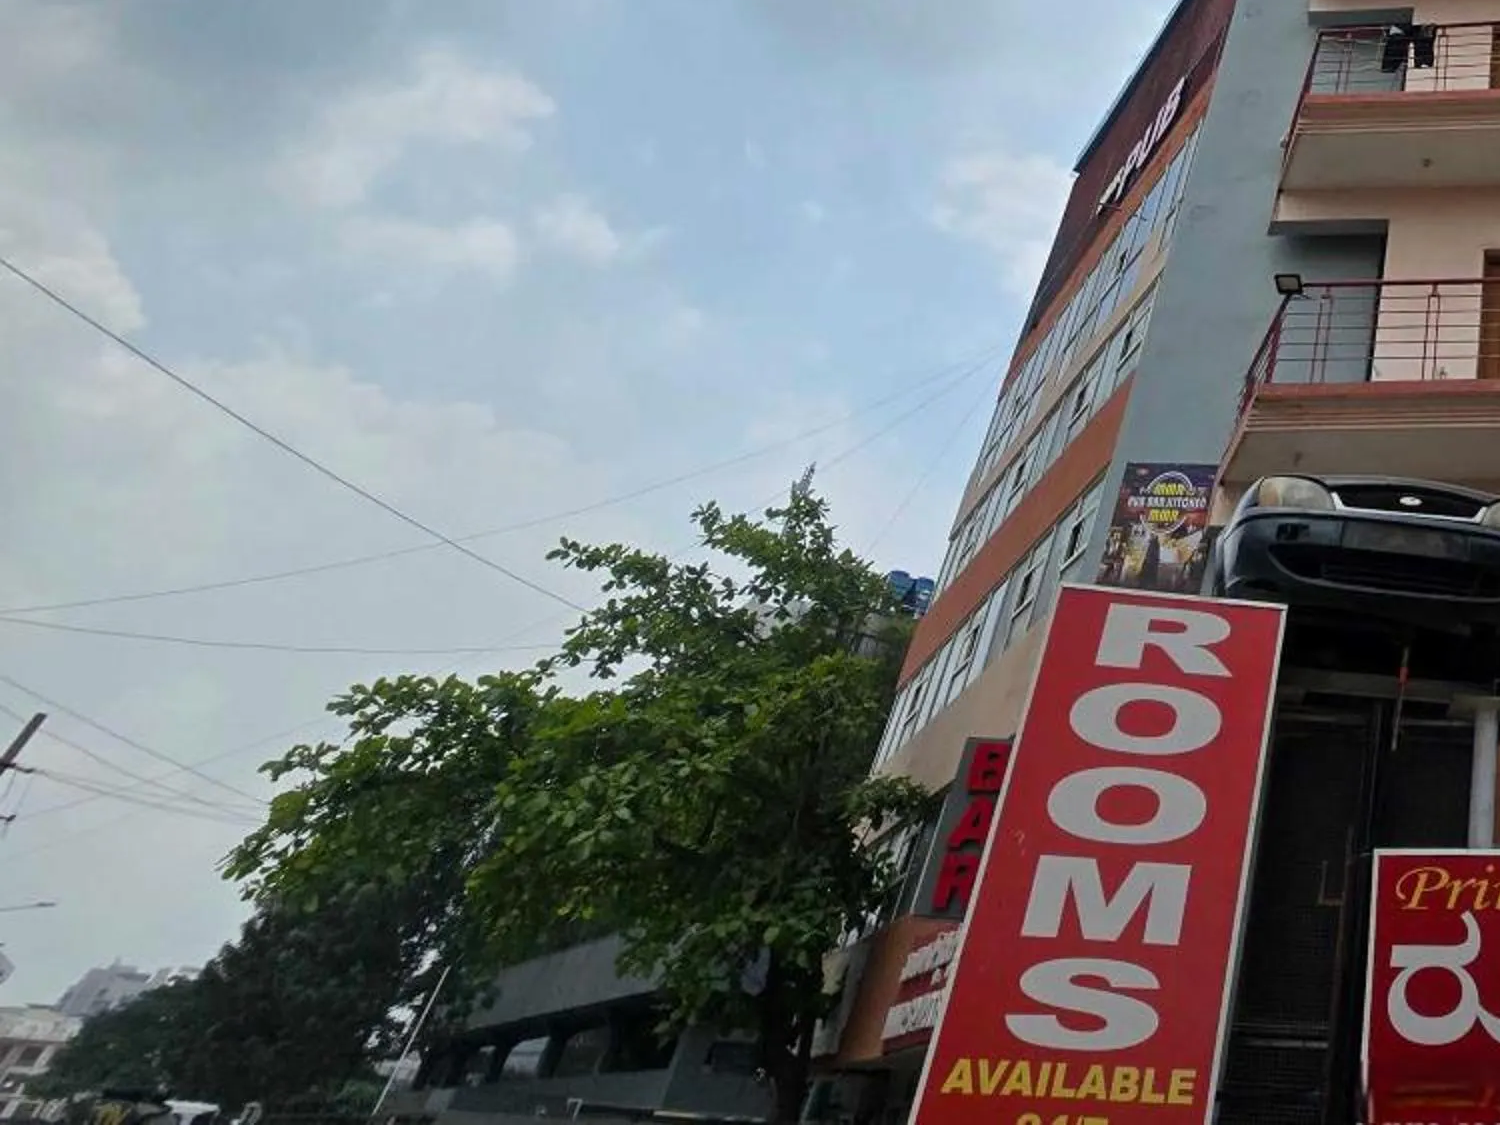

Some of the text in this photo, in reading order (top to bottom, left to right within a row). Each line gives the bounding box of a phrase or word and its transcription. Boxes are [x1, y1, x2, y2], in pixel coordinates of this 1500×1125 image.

[931, 741, 1012, 913] BAR
[1004, 602, 1232, 1051] ROOMS
[941, 1058, 1197, 1106] AVAILABLE
